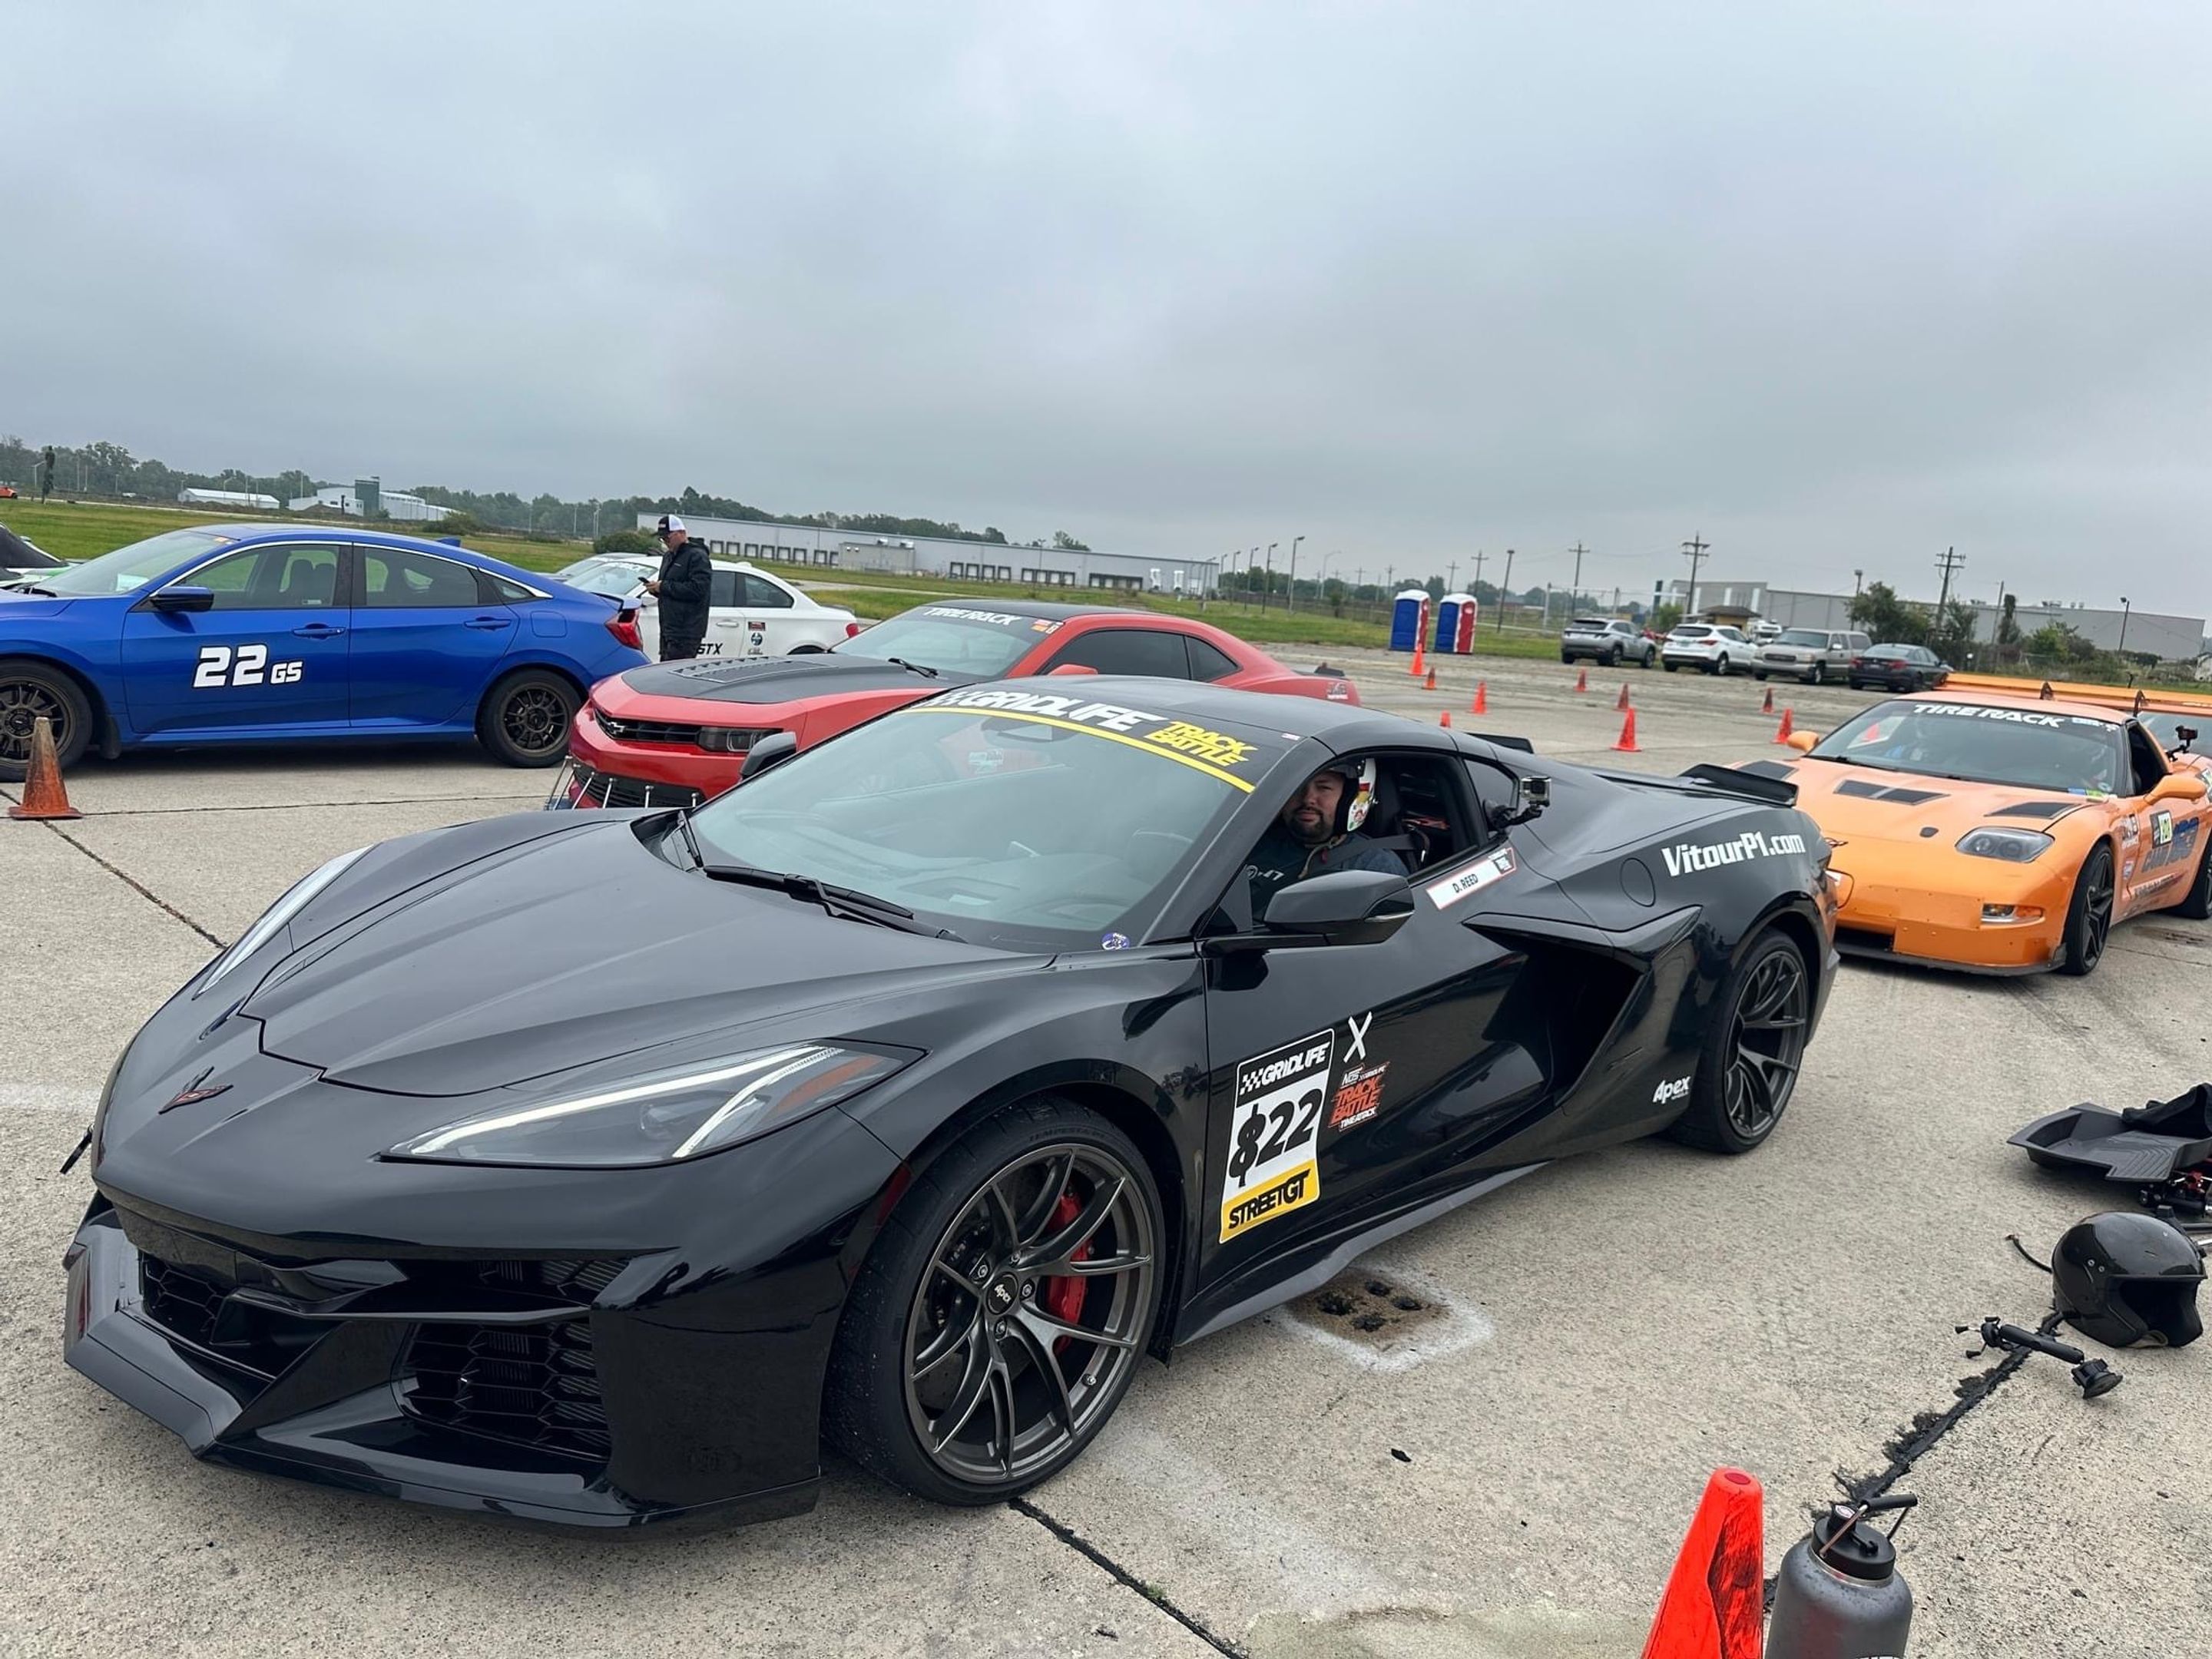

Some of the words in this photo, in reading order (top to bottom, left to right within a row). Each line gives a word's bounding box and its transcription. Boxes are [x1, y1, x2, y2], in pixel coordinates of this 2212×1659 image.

[194, 644, 267, 687] 22
[270, 661, 303, 684] GS
[968, 691, 1169, 732] GRIDLIFE
[1914, 704, 1980, 717] TIRE
[1978, 707, 2067, 728] RACK
[1145, 731, 1250, 767] BATTLE
[1163, 720, 1259, 754] TRACK
[1661, 831, 1806, 876] VitourP1.com
[1460, 874, 1479, 890] REED
[1343, 1012, 1373, 1063] X
[1261, 1041, 1331, 1086] GRIDLIFE
[1330, 1089, 1380, 1124] BATTLE
[1336, 1077, 1379, 1108] TRACK
